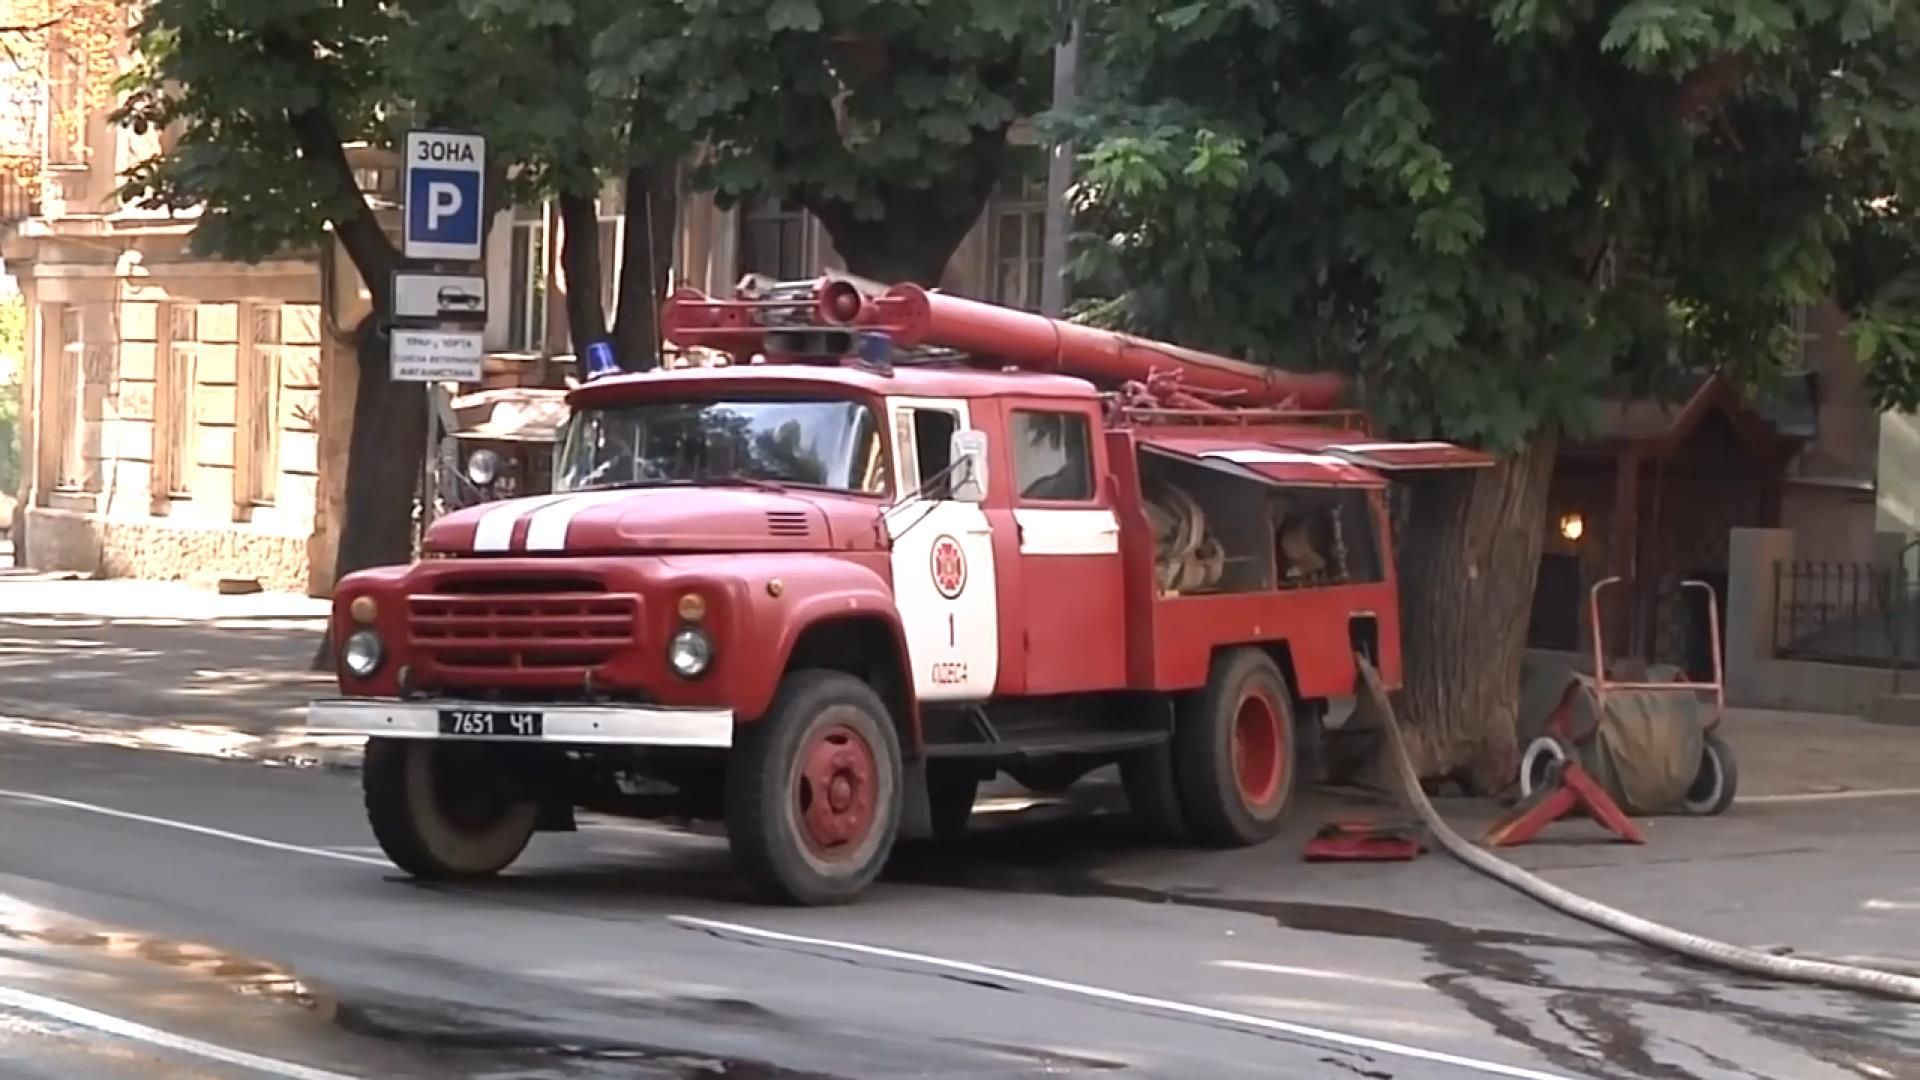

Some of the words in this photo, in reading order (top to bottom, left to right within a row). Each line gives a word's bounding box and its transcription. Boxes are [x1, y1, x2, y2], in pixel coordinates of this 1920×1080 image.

[417, 140, 475, 163] ЗОНА
[428, 182, 462, 231] P
[948, 612, 955, 648] 1
[452, 712, 493, 733] 7651
